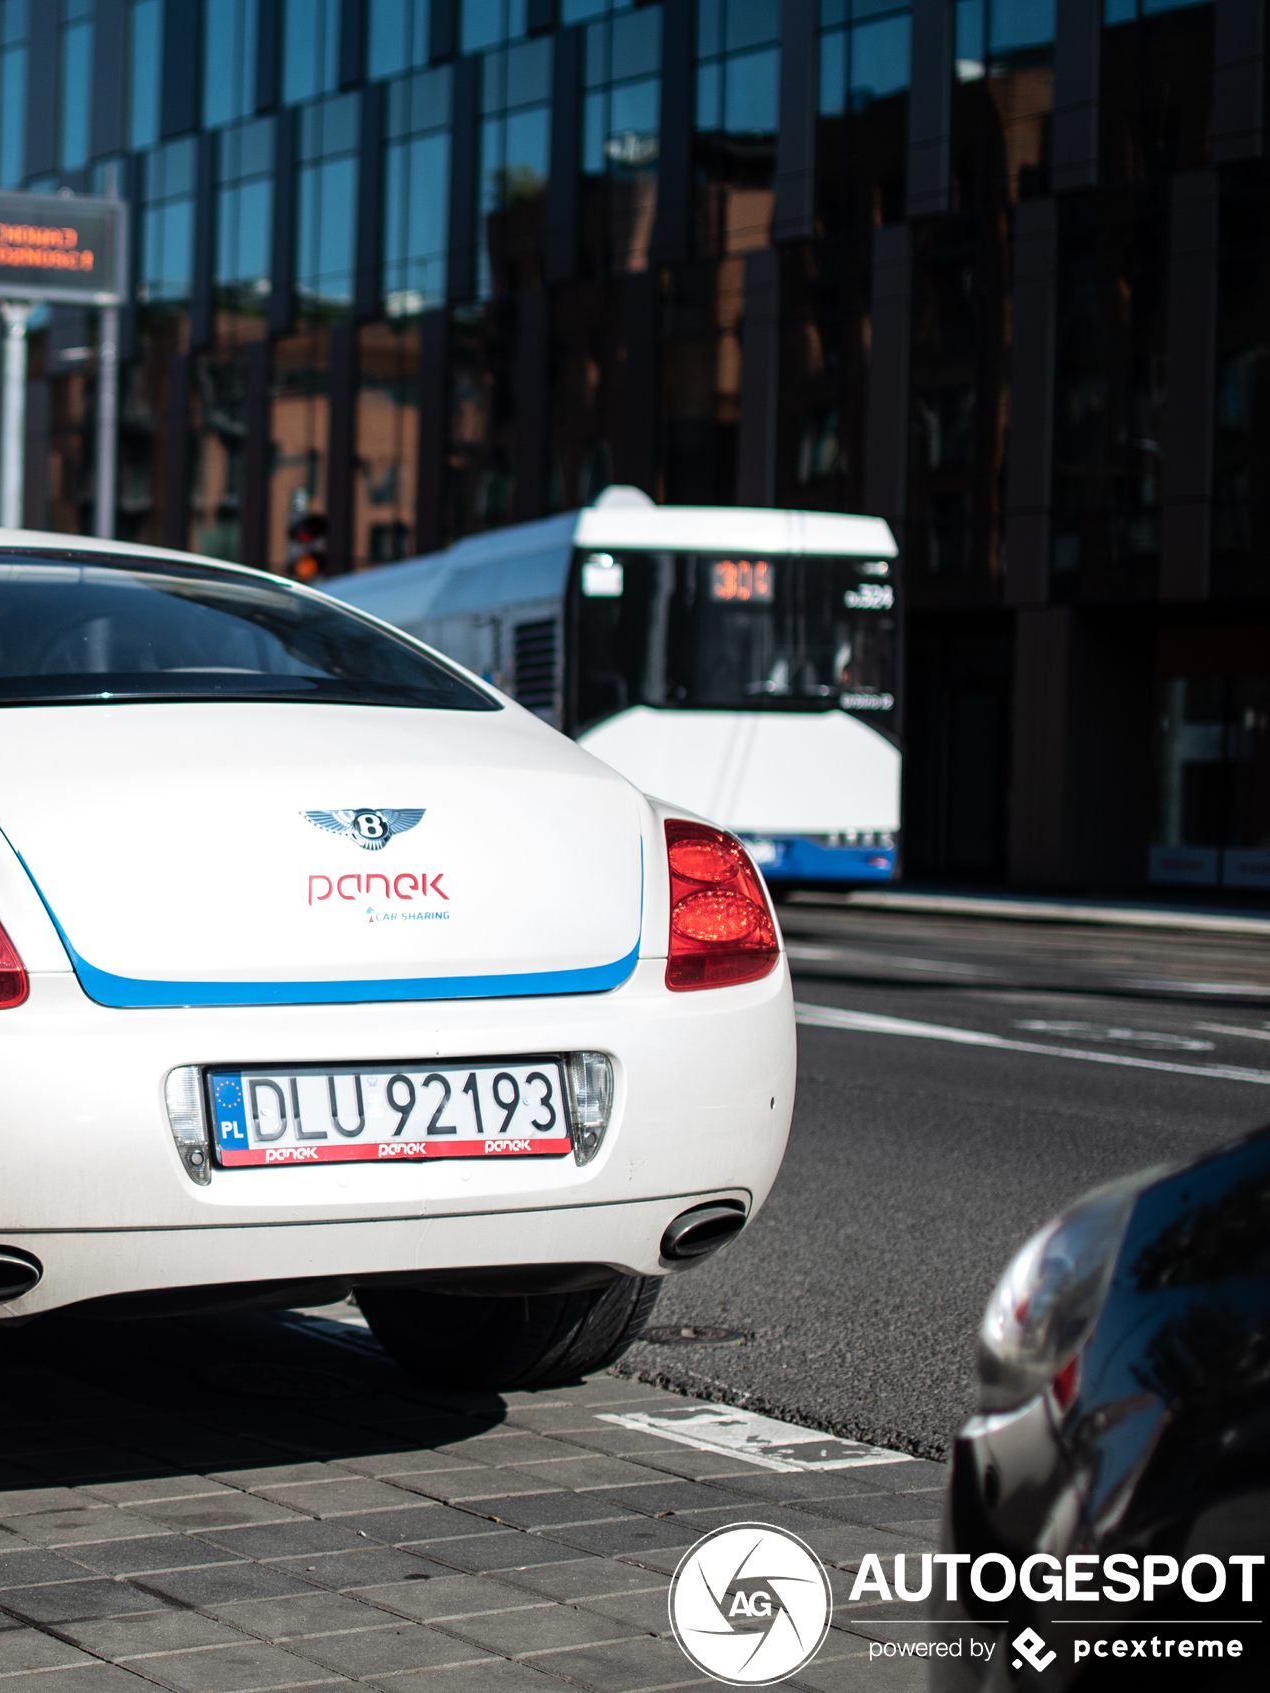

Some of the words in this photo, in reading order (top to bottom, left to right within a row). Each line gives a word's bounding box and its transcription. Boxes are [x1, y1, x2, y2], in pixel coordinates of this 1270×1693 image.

[308, 873, 450, 906] panek
[375, 913, 398, 921] CAR
[401, 911, 450, 921] SHARING
[248, 1073, 367, 1142] DLU
[385, 1072, 558, 1137] 92193
[221, 1120, 245, 1139] PL
[265, 1146, 319, 1163] panek
[378, 1141, 427, 1158] panek
[484, 1138, 531, 1154] panek
